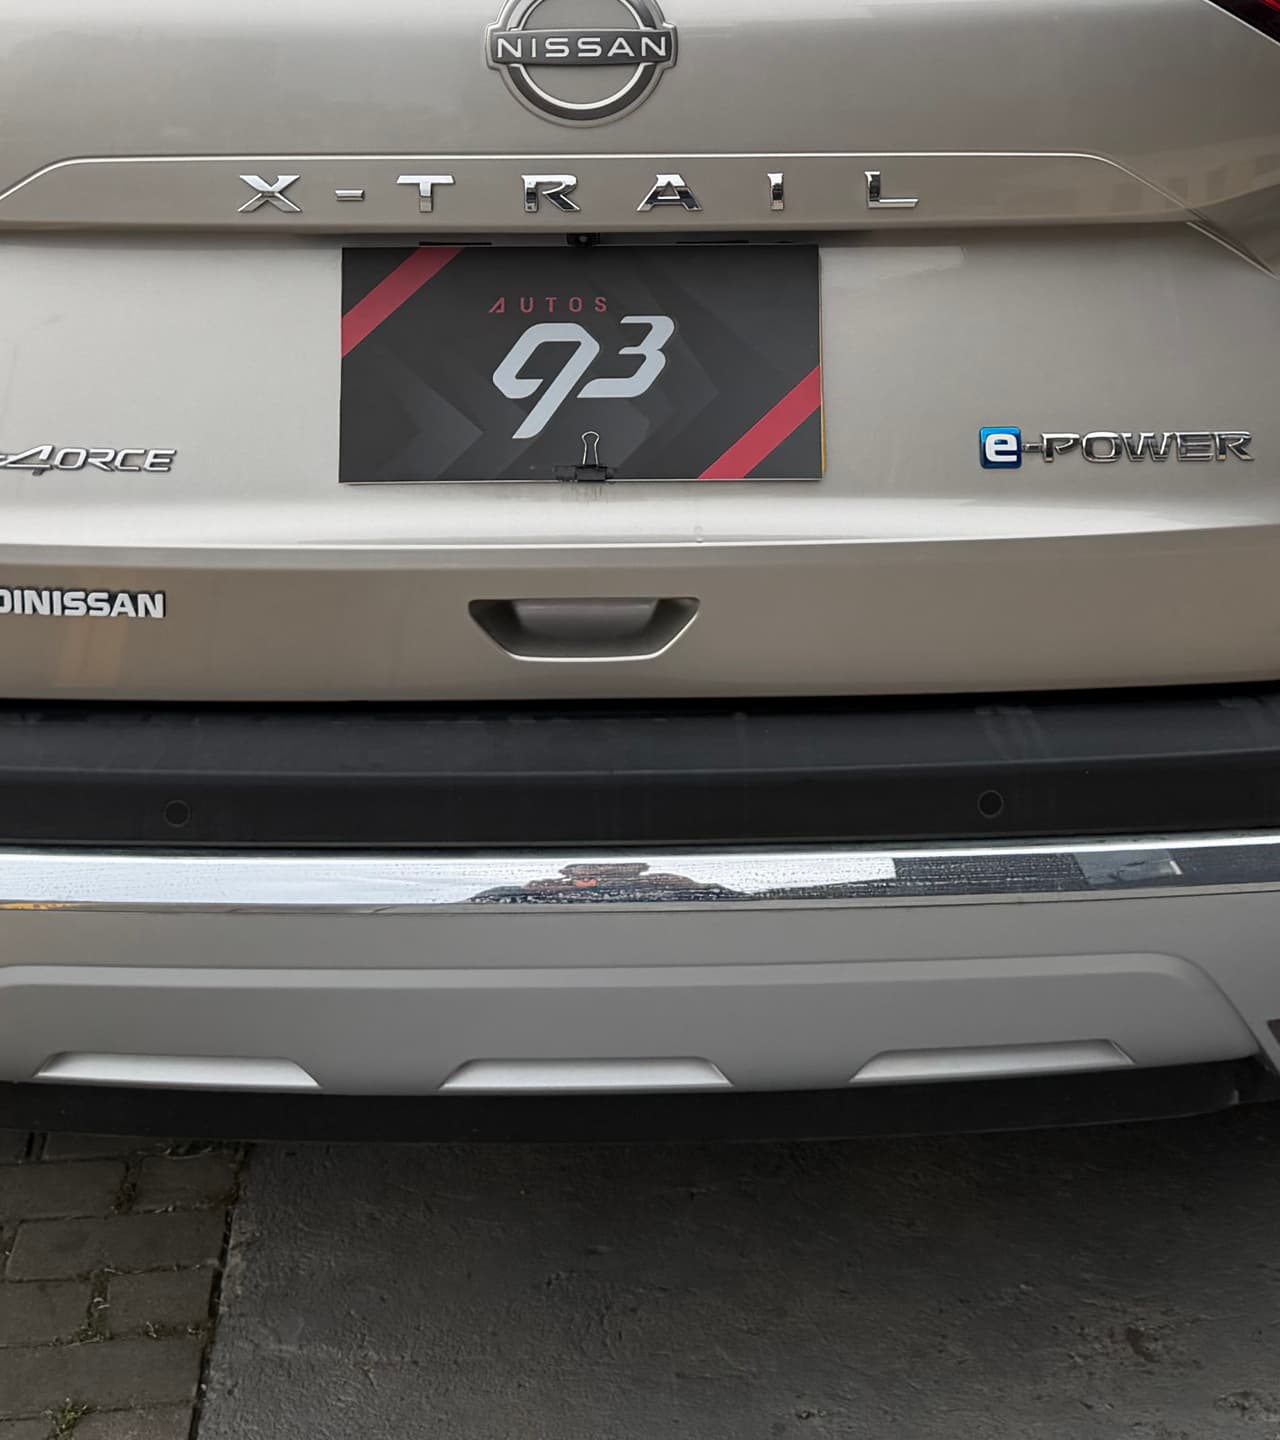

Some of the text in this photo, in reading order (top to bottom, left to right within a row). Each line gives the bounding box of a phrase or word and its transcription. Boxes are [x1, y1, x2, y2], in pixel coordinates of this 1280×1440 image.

[497, 35, 667, 58] NISSAN
[236, 171, 920, 213] X-TRAIL
[487, 296, 609, 314] AUTOS
[492, 315, 675, 440] 93
[983, 430, 1256, 464] e-POWER
